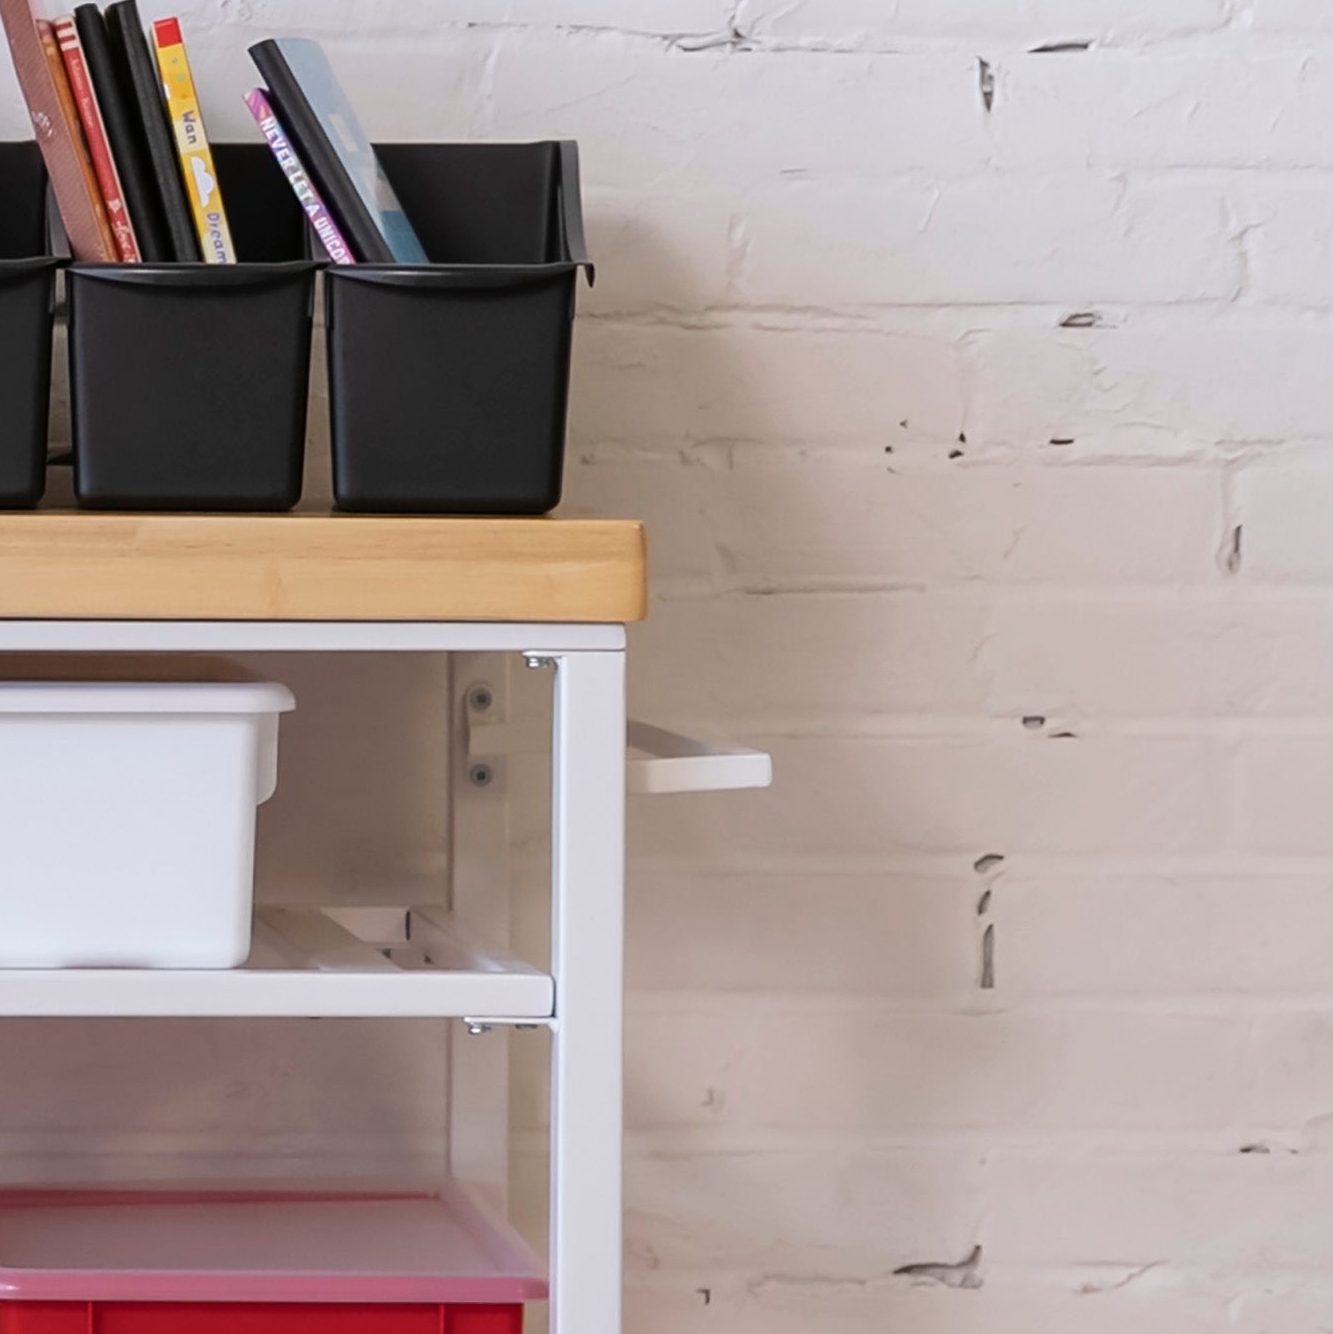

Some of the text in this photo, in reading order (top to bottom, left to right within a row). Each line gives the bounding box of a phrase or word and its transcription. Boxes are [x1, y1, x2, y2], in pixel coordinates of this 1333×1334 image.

[182, 110, 197, 145] Wan
[259, 118, 295, 169] NEVER
[289, 171, 315, 202] LET
[306, 204, 320, 216] A
